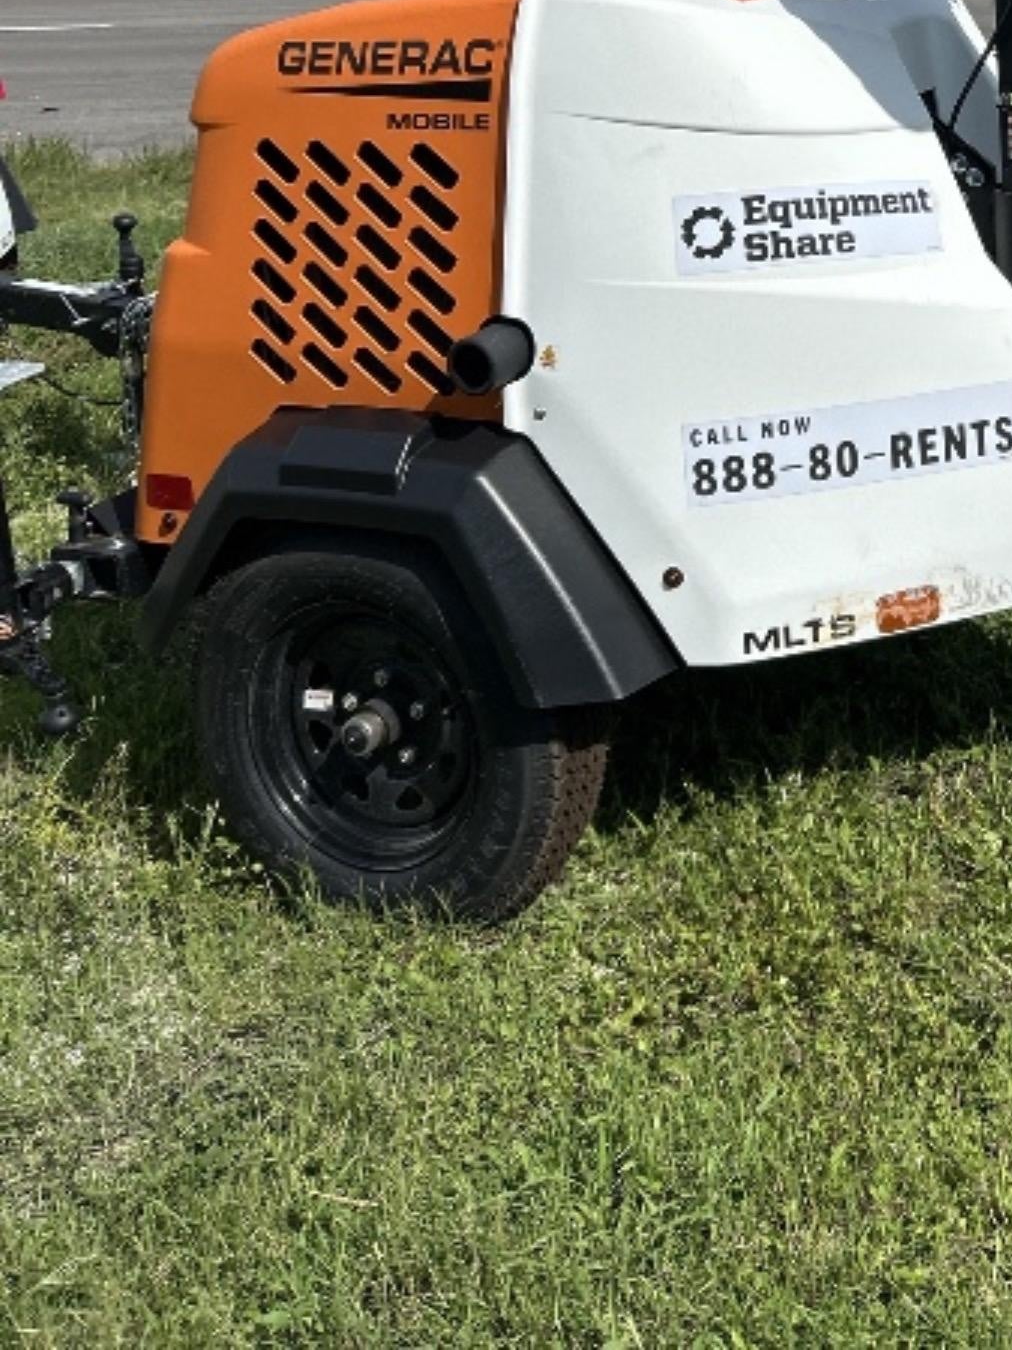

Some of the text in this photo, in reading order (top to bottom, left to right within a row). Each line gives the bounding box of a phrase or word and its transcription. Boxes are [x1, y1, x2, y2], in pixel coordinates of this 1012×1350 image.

[278, 39, 496, 76] GENERAC
[386, 113, 490, 131] MOBILE
[740, 187, 932, 229] Equipment
[743, 230, 856, 263] Share
[688, 415, 812, 448] CALL NOW
